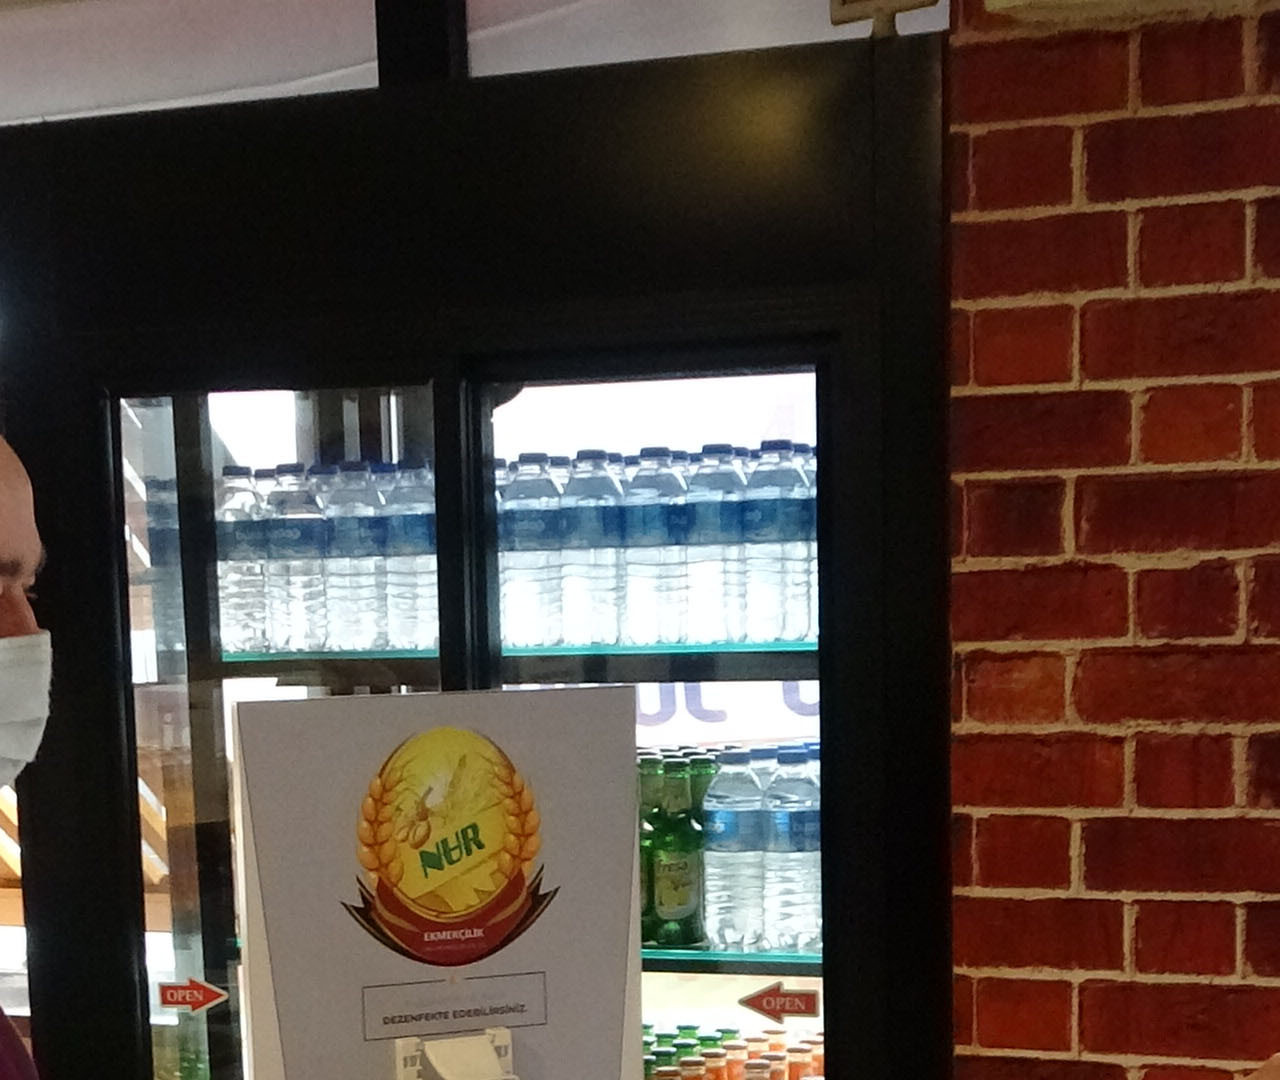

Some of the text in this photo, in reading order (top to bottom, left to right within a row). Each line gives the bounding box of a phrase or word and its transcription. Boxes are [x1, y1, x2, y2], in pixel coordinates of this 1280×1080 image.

[166, 989, 204, 1002] OPEN
[762, 996, 807, 1011] OPEN
[382, 1010, 450, 1025] DEZENFEKTE
